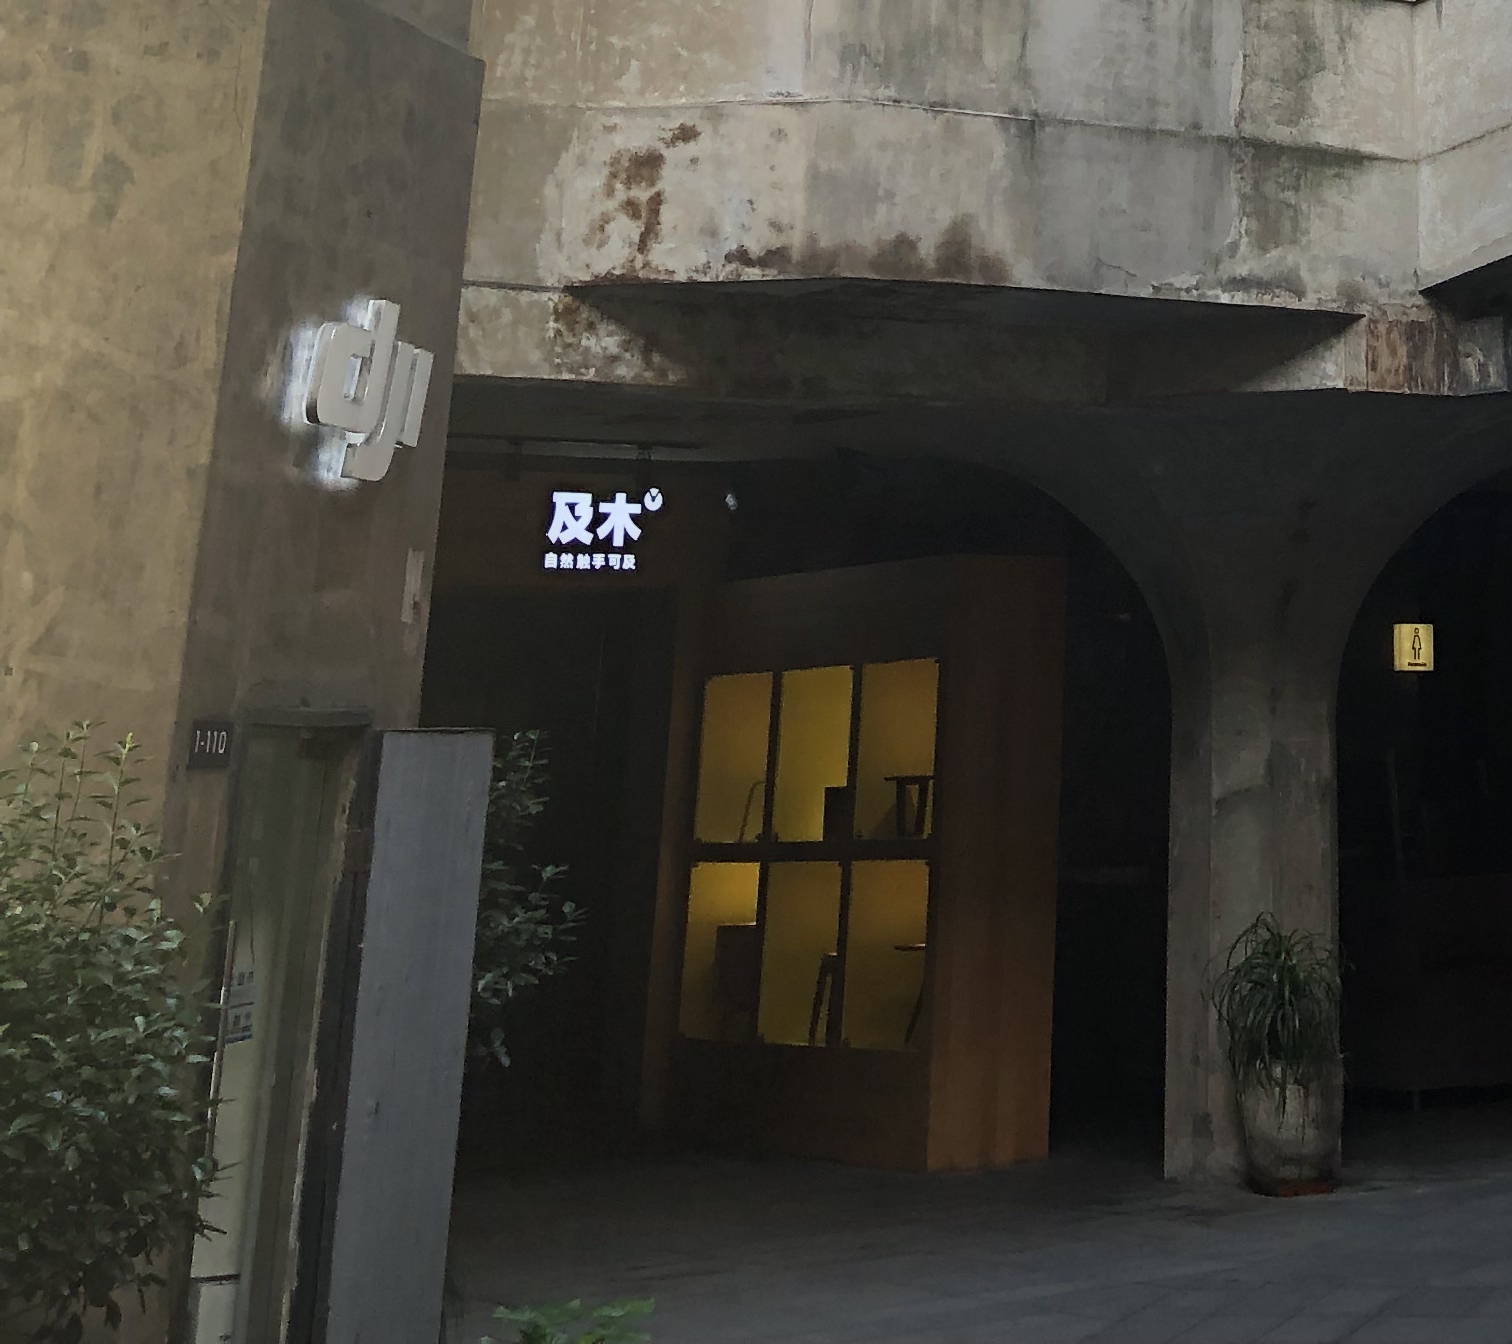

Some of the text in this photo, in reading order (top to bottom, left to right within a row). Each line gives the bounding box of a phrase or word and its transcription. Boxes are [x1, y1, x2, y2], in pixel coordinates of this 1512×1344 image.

[545, 491, 642, 547] 及木
[543, 552, 637, 570] 自然触手可及
[194, 730, 227, 754] 1-110
